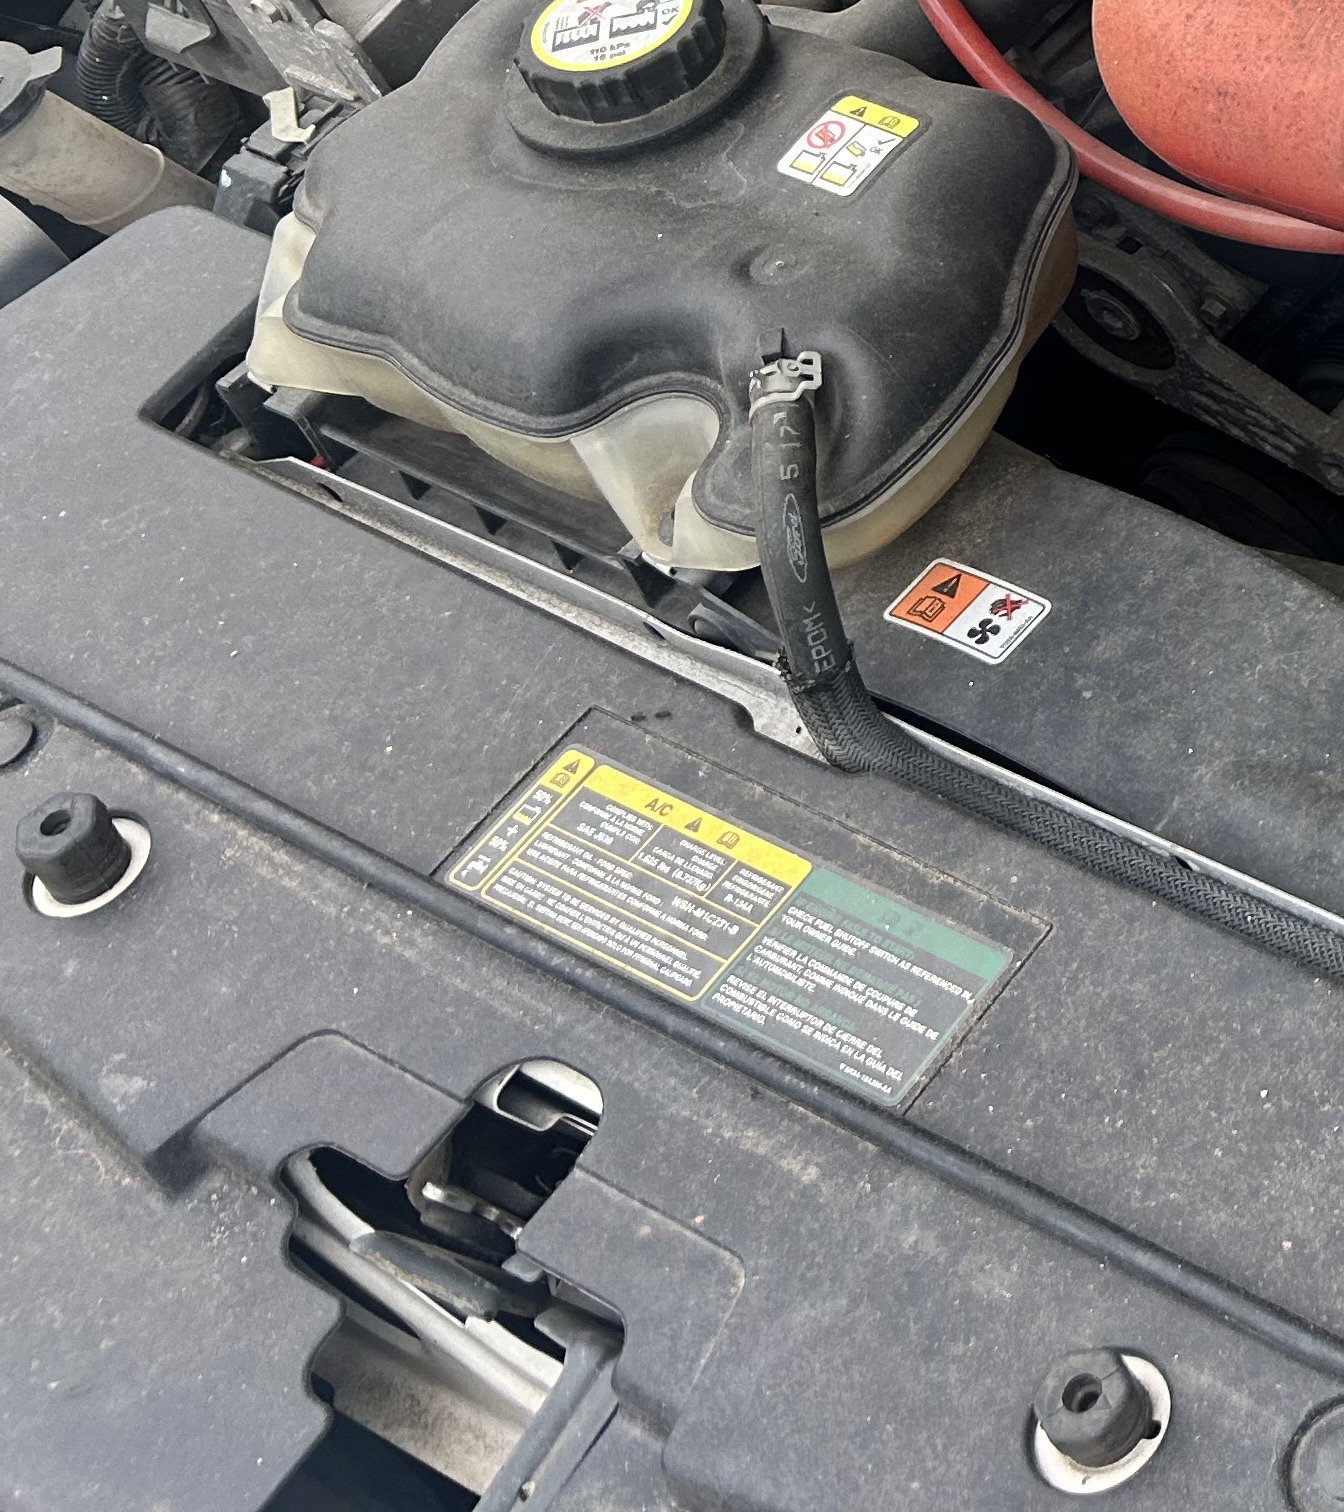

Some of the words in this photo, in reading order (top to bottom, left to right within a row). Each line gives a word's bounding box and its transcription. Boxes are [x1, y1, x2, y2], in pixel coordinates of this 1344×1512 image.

[661, 6, 680, 15] OK
[590, 47, 607, 57] 110
[610, 42, 631, 52] kPa
[781, 461, 800, 481] 5
[532, 789, 554, 804] 50%
[605, 804, 637, 822] COMPLIES
[644, 797, 674, 816] A/C
[576, 822, 596, 835] SAE
[615, 818, 624, 826] LA
[652, 846, 675, 860] CARGA
[679, 839, 706, 855] CHARGE
[560, 864, 578, 875] PARA
[657, 861, 672, 872] lbs
[611, 877, 621, 885] LA
[536, 881, 561, 896] SYSTEM
[561, 893, 571, 901] TO
[579, 902, 609, 920] SERVICED
[609, 917, 619, 925] BY
[618, 921, 651, 941] QUALIFIED
[723, 893, 754, 912] R-134A
[670, 896, 740, 934] WSH-M1C231-B
[778, 914, 803, 930] YOUR
[802, 925, 831, 943] OWNER
[830, 939, 858, 956] GUIDE.
[867, 932, 882, 943] TO
[787, 906, 815, 923] CHECK
[813, 919, 835, 933] FUEL
[833, 929, 870, 949] SHUTOFF
[868, 945, 900, 964] SWITCH
[898, 960, 911, 969] AS
[909, 966, 963, 994] REFERENCED
[753, 944, 804, 973] CARBURANT,
[803, 969, 833, 987] COMME
[864, 999, 889, 1015] DANS
[887, 1010, 900, 1021] LE
[899, 1016, 926, 1034] GUIDE
[924, 1029, 939, 1040] DE
[796, 954, 809, 963] LA
[807, 959, 853, 985] COMMANDE
[852, 981, 865, 991] DE
[864, 987, 905, 1011] COUPURE
[903, 1006, 917, 1017] DE
[711, 992, 767, 1024] PROPIETARIO.
[726, 974, 757, 994] REVISE
[755, 989, 768, 1000] EL
[767, 995, 824, 1027] INTERRUPTOR
[823, 1023, 836, 1033] DE
[835, 1029, 866, 1049] CIERRE
[865, 1044, 884, 1058] DEL
[719, 983, 777, 1016] COMBUSTIBLE
[775, 1012, 802, 1029] COMO
[800, 1025, 813, 1035] SE
[812, 1031, 842, 1050] INDICA
[840, 1045, 854, 1055] EN
[852, 1051, 866, 1062] LA
[864, 1055, 888, 1073] GUÍA
[885, 1067, 905, 1081] DEL
